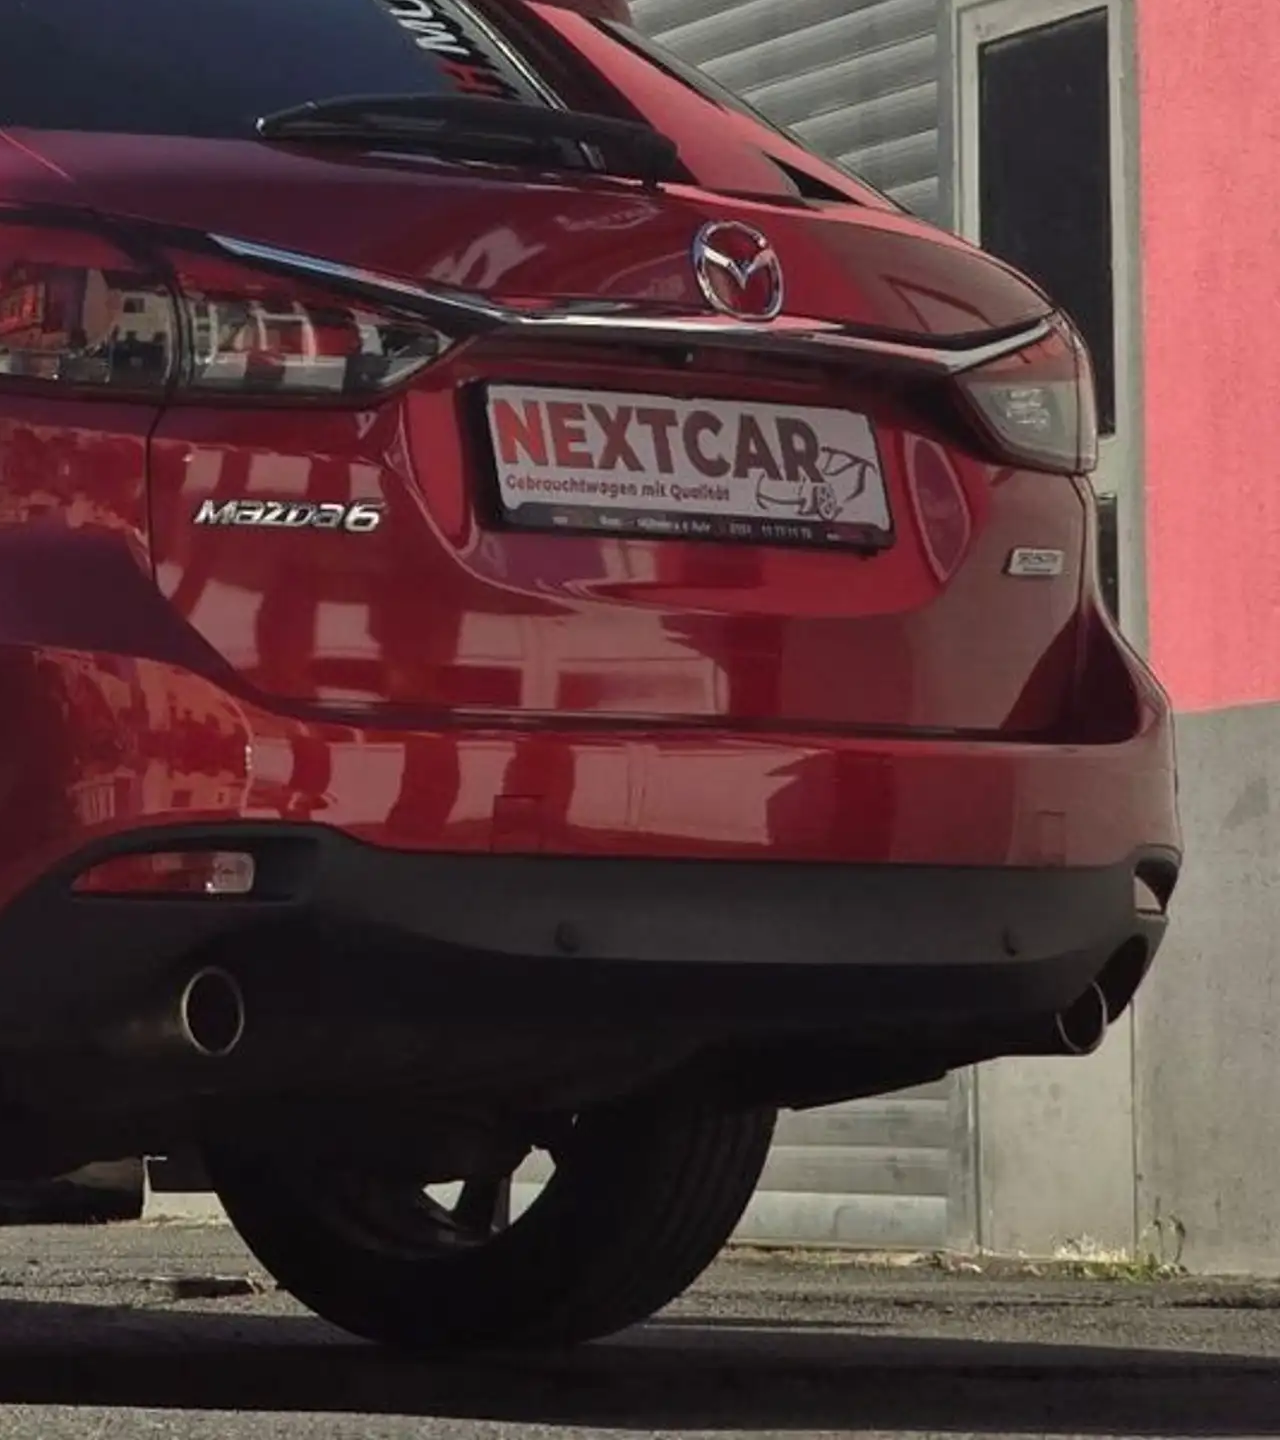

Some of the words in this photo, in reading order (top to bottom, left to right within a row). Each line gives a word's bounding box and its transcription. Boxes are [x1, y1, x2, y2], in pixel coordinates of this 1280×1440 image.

[491, 397, 826, 483] NEXTCAR
[506, 473, 638, 498] Gebrauchtwagen
[641, 481, 666, 498] mit
